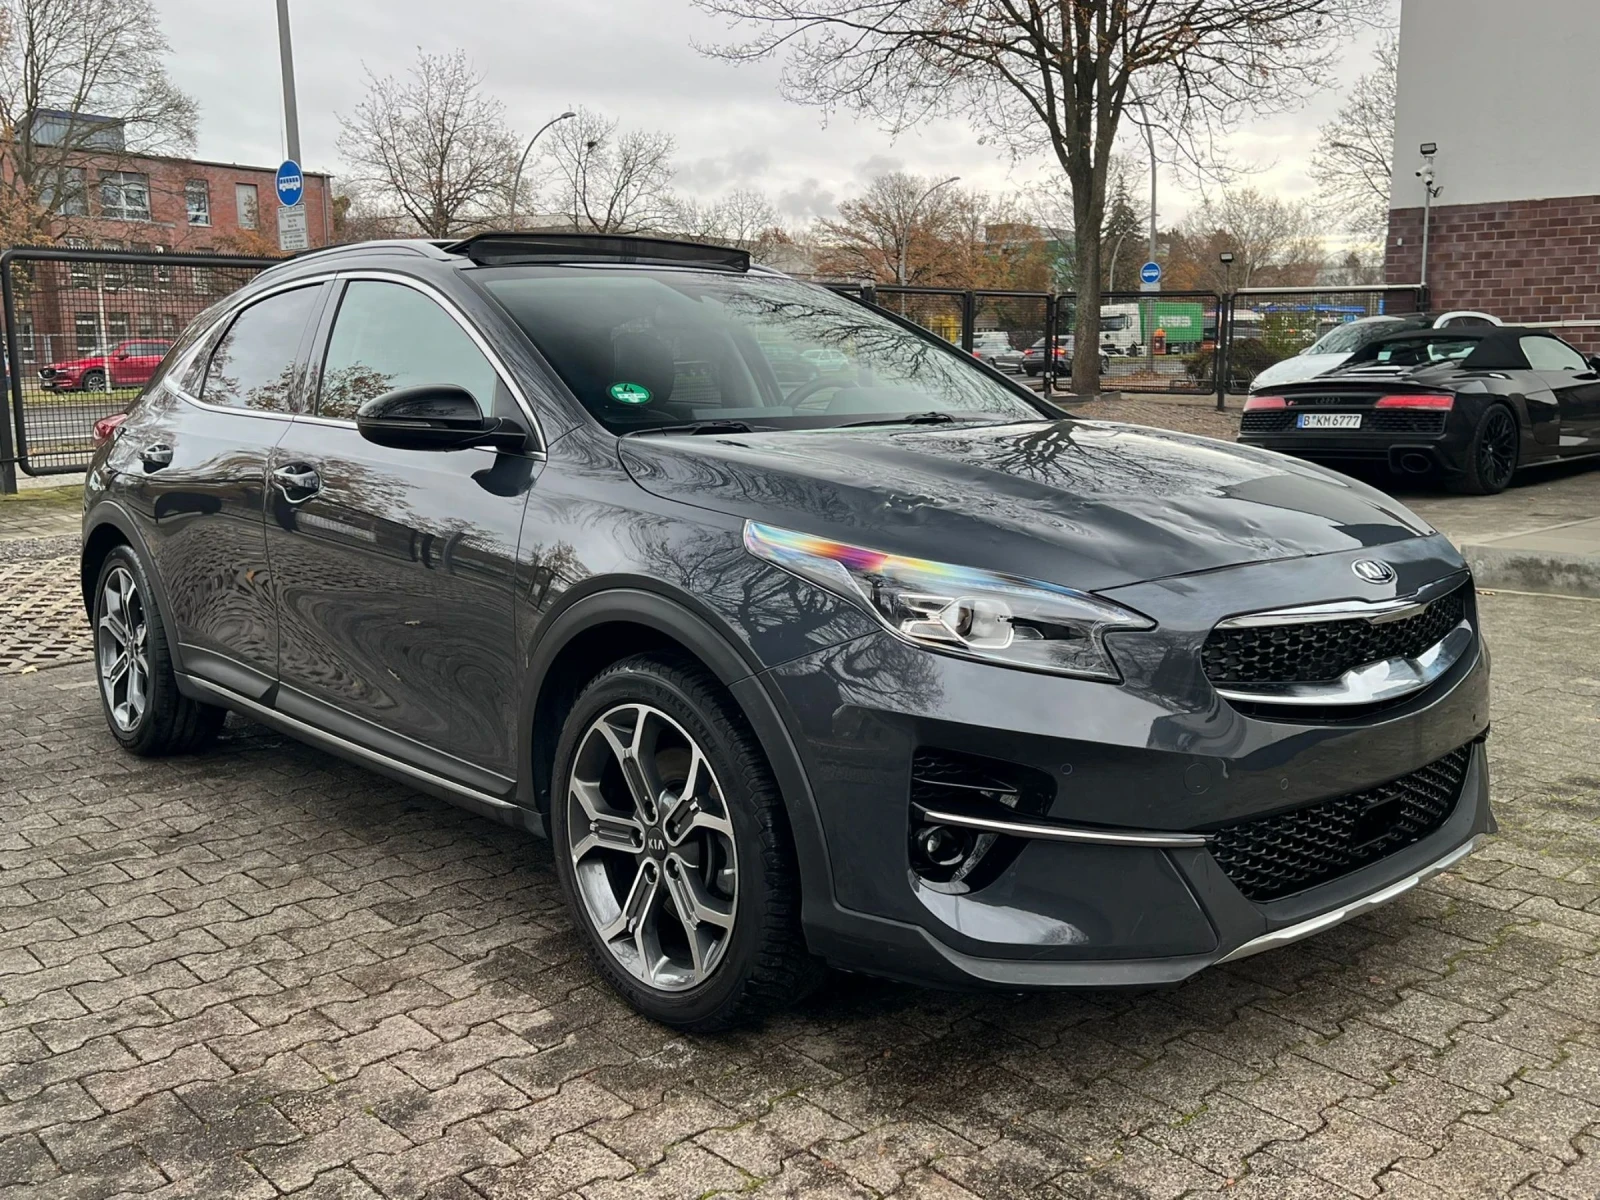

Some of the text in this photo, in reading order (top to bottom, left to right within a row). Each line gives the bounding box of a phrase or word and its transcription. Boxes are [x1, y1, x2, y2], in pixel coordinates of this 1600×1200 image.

[1303, 415, 1311, 427] B
[1356, 561, 1392, 579] KIA
[647, 838, 665, 850] KIA
